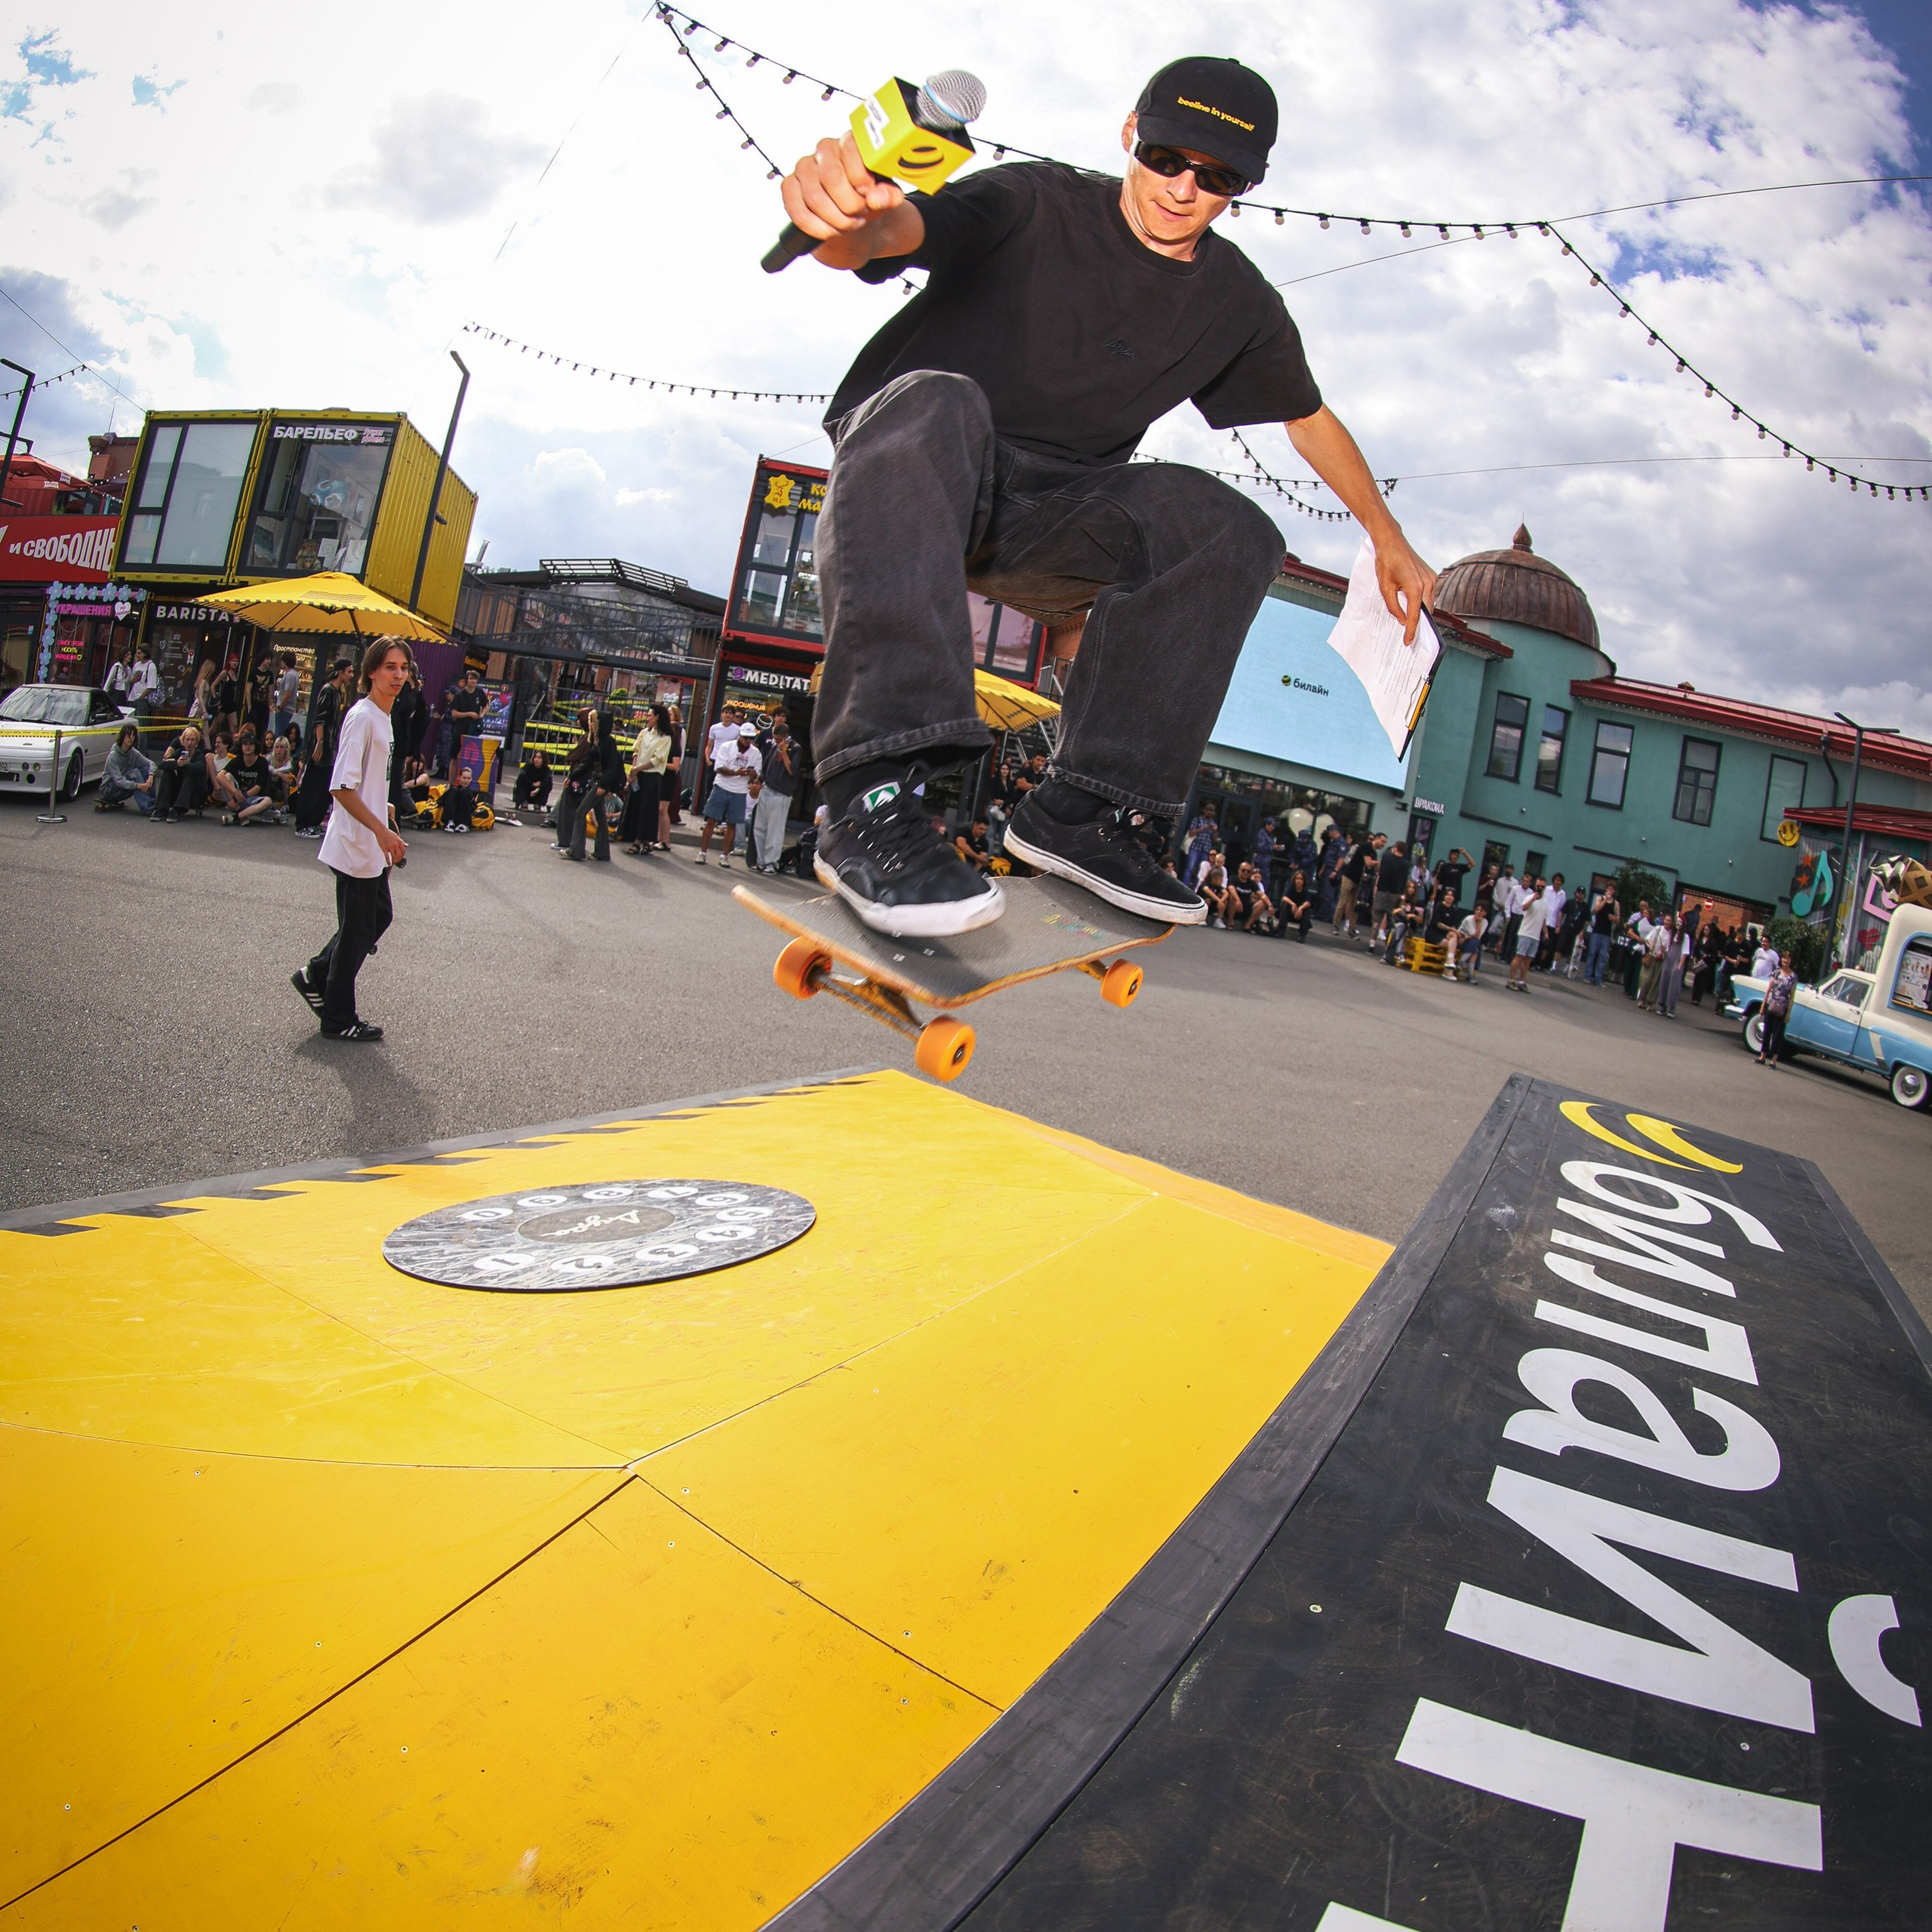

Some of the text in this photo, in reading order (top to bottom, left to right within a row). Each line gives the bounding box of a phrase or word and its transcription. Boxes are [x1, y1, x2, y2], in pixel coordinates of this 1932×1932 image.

[1177, 96, 1255, 132] beeline in yourself
[273, 426, 358, 441] БАРЕЛЬЕФ
[55, 604, 112, 617] УКРАШЕНИЯ
[156, 605, 229, 622] BARISTA
[1294, 678, 1330, 697] билайн
[1414, 796, 1444, 814] ДРАКОНА
